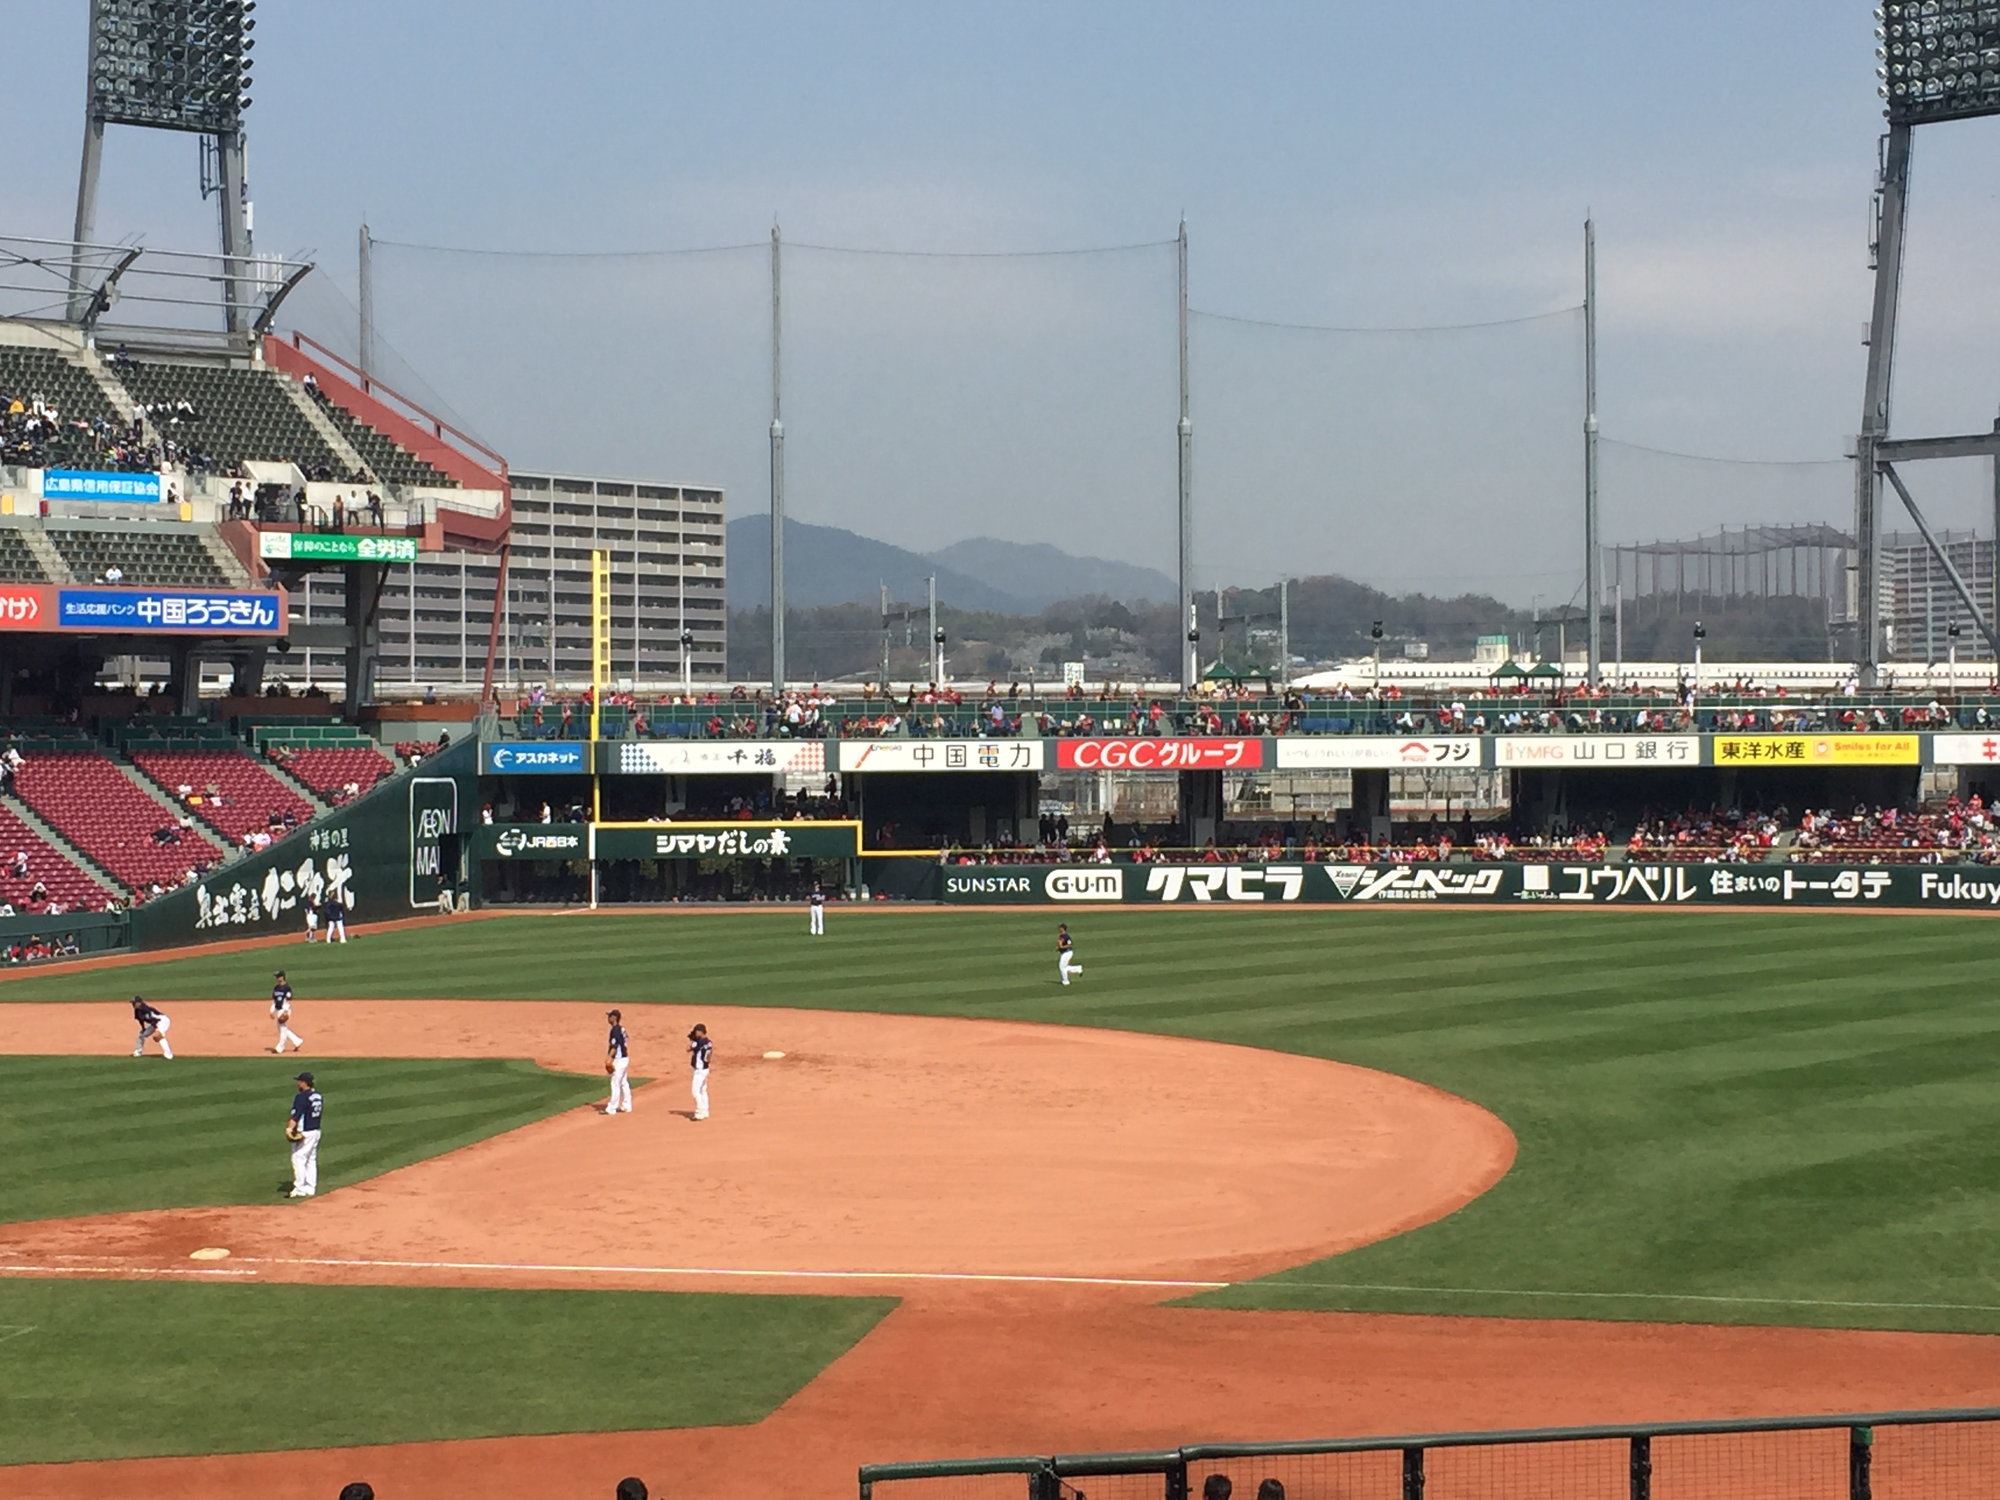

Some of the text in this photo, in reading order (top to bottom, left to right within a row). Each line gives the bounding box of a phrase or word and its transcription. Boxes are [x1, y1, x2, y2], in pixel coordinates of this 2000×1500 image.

[357, 538, 415, 559] 全労済
[137, 597, 274, 625] 中国ろうきん
[913, 743, 1032, 768] 中国電力
[1074, 741, 1244, 767] CGCグループ
[1433, 742, 1470, 762] フジ
[1516, 746, 1564, 759] YMFG
[1574, 741, 1689, 760] 山口銀行
[1721, 741, 1805, 760] 東洋水産
[1876, 742, 1892, 751] for
[1895, 742, 1910, 751] All
[515, 752, 579, 764] アスカネット
[527, 835, 579, 847] JR西日本
[656, 828, 792, 855] シマヤだしの素
[947, 877, 1031, 893] SUNSTAR
[1146, 866, 1304, 901] クマヒラ
[1353, 865, 1503, 899] ジーベック
[1559, 865, 1697, 901] ユウベル
